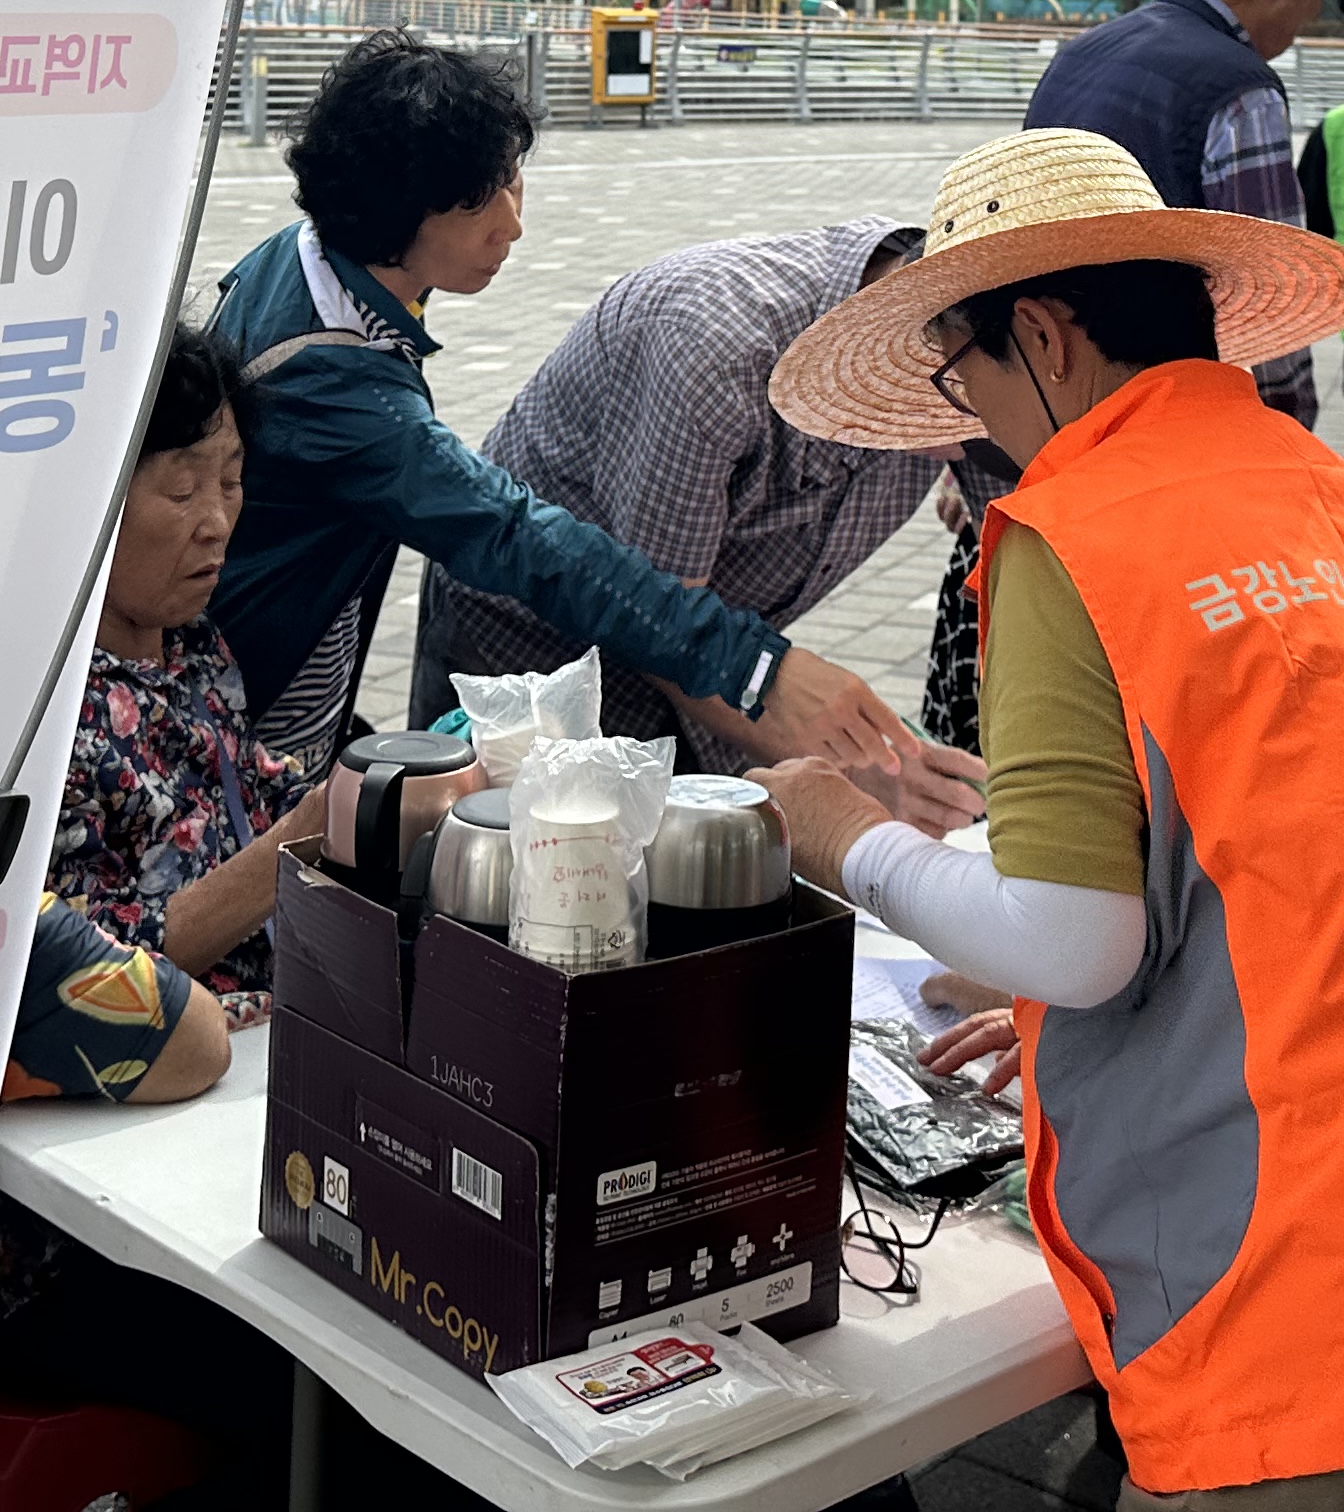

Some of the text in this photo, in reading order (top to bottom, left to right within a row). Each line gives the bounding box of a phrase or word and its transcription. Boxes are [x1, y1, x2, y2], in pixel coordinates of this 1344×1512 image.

[430, 1055, 495, 1108] 1JAHC3
[326, 1167, 347, 1206] 80
[370, 1236, 499, 1373] Mr.Copy
[720, 1297, 730, 1313] 5
[765, 1276, 795, 1299] 2500
